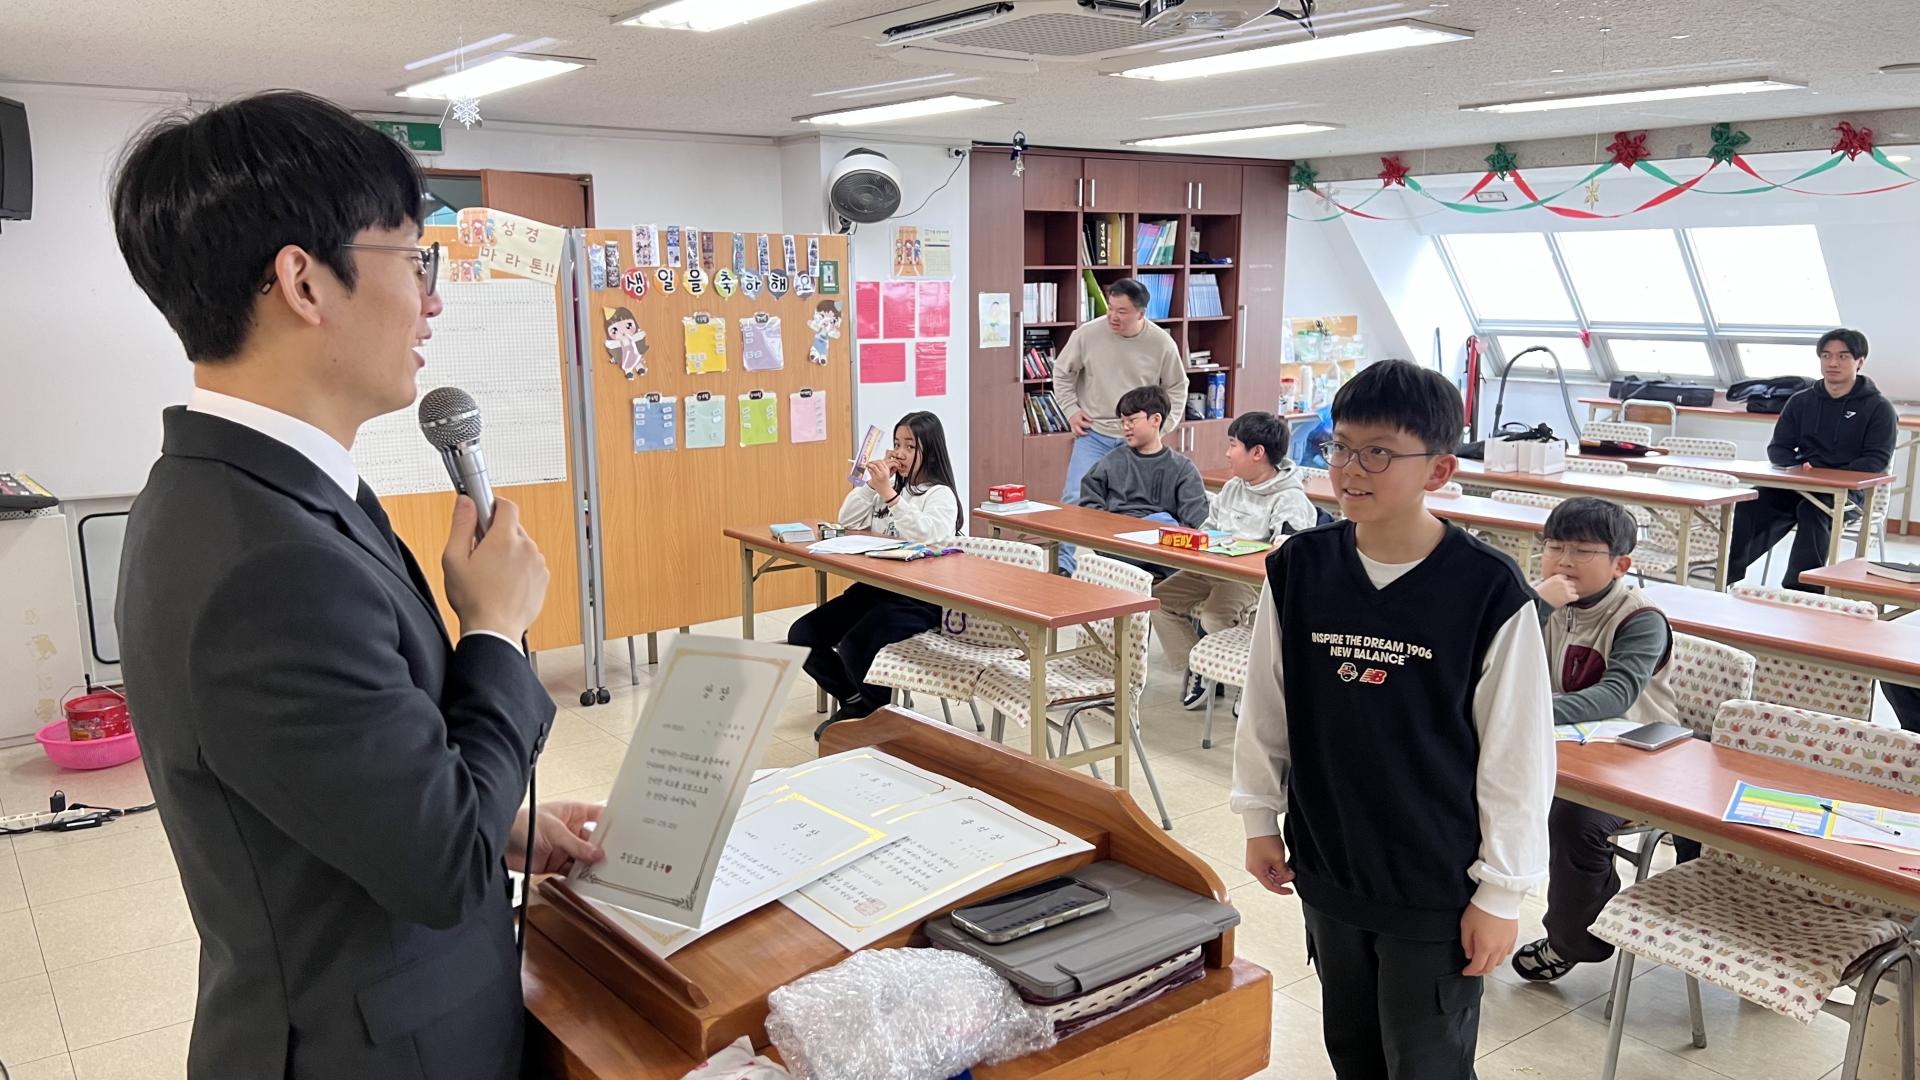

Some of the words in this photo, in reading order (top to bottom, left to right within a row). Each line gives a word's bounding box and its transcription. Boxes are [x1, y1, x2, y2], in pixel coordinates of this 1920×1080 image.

[502, 221, 540, 244] 성경
[480, 246, 555, 278] 마라톤!!
[626, 269, 702, 294] 생일을
[719, 270, 814, 294] 축하해요
[1311, 632, 1344, 645] INSPIRE
[1345, 634, 1363, 647] THE
[1363, 636, 1404, 653] DREAM
[1406, 644, 1433, 660] 1906
[1330, 645, 1353, 659] NEW
[1353, 648, 1405, 666] BALANCE
